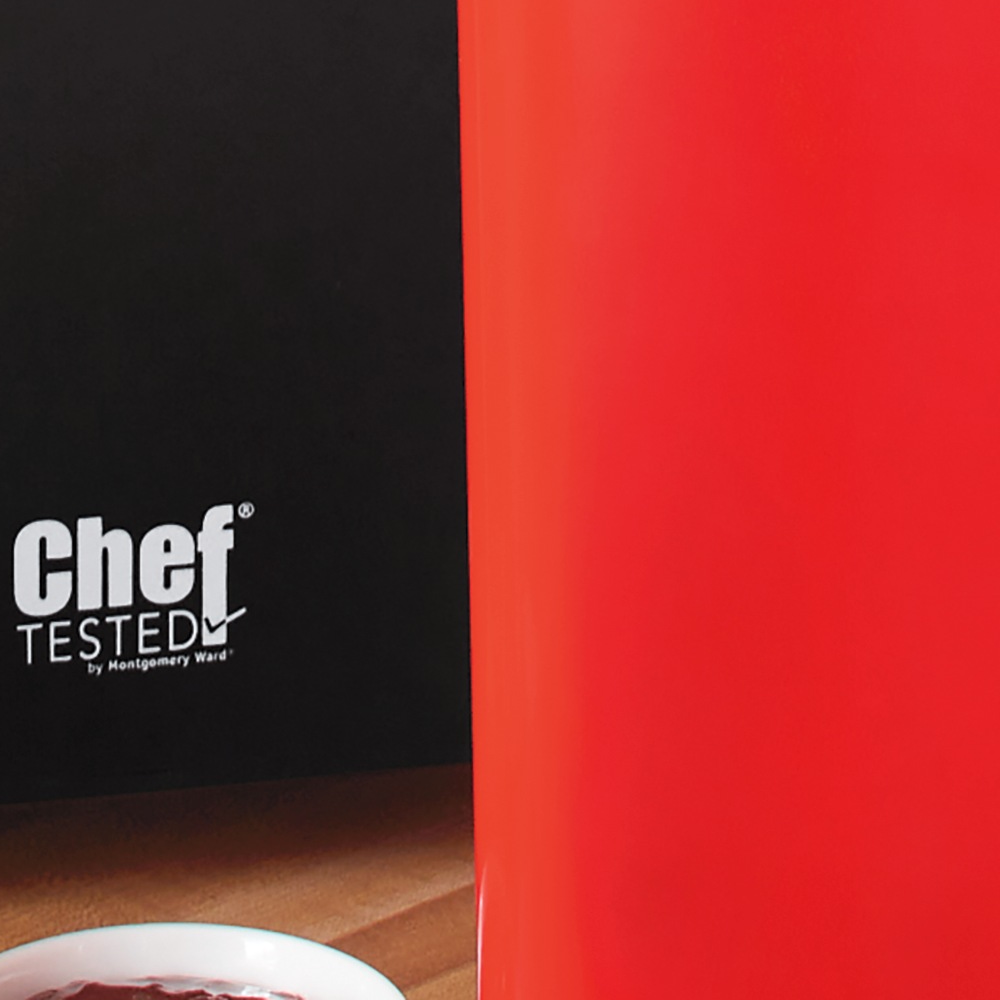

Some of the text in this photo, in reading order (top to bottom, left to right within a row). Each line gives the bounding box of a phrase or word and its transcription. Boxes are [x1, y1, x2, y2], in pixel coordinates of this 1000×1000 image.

[13, 503, 235, 647] Chef
[16, 609, 199, 665] TESTED
[88, 649, 228, 675] by Montgomery Ward
